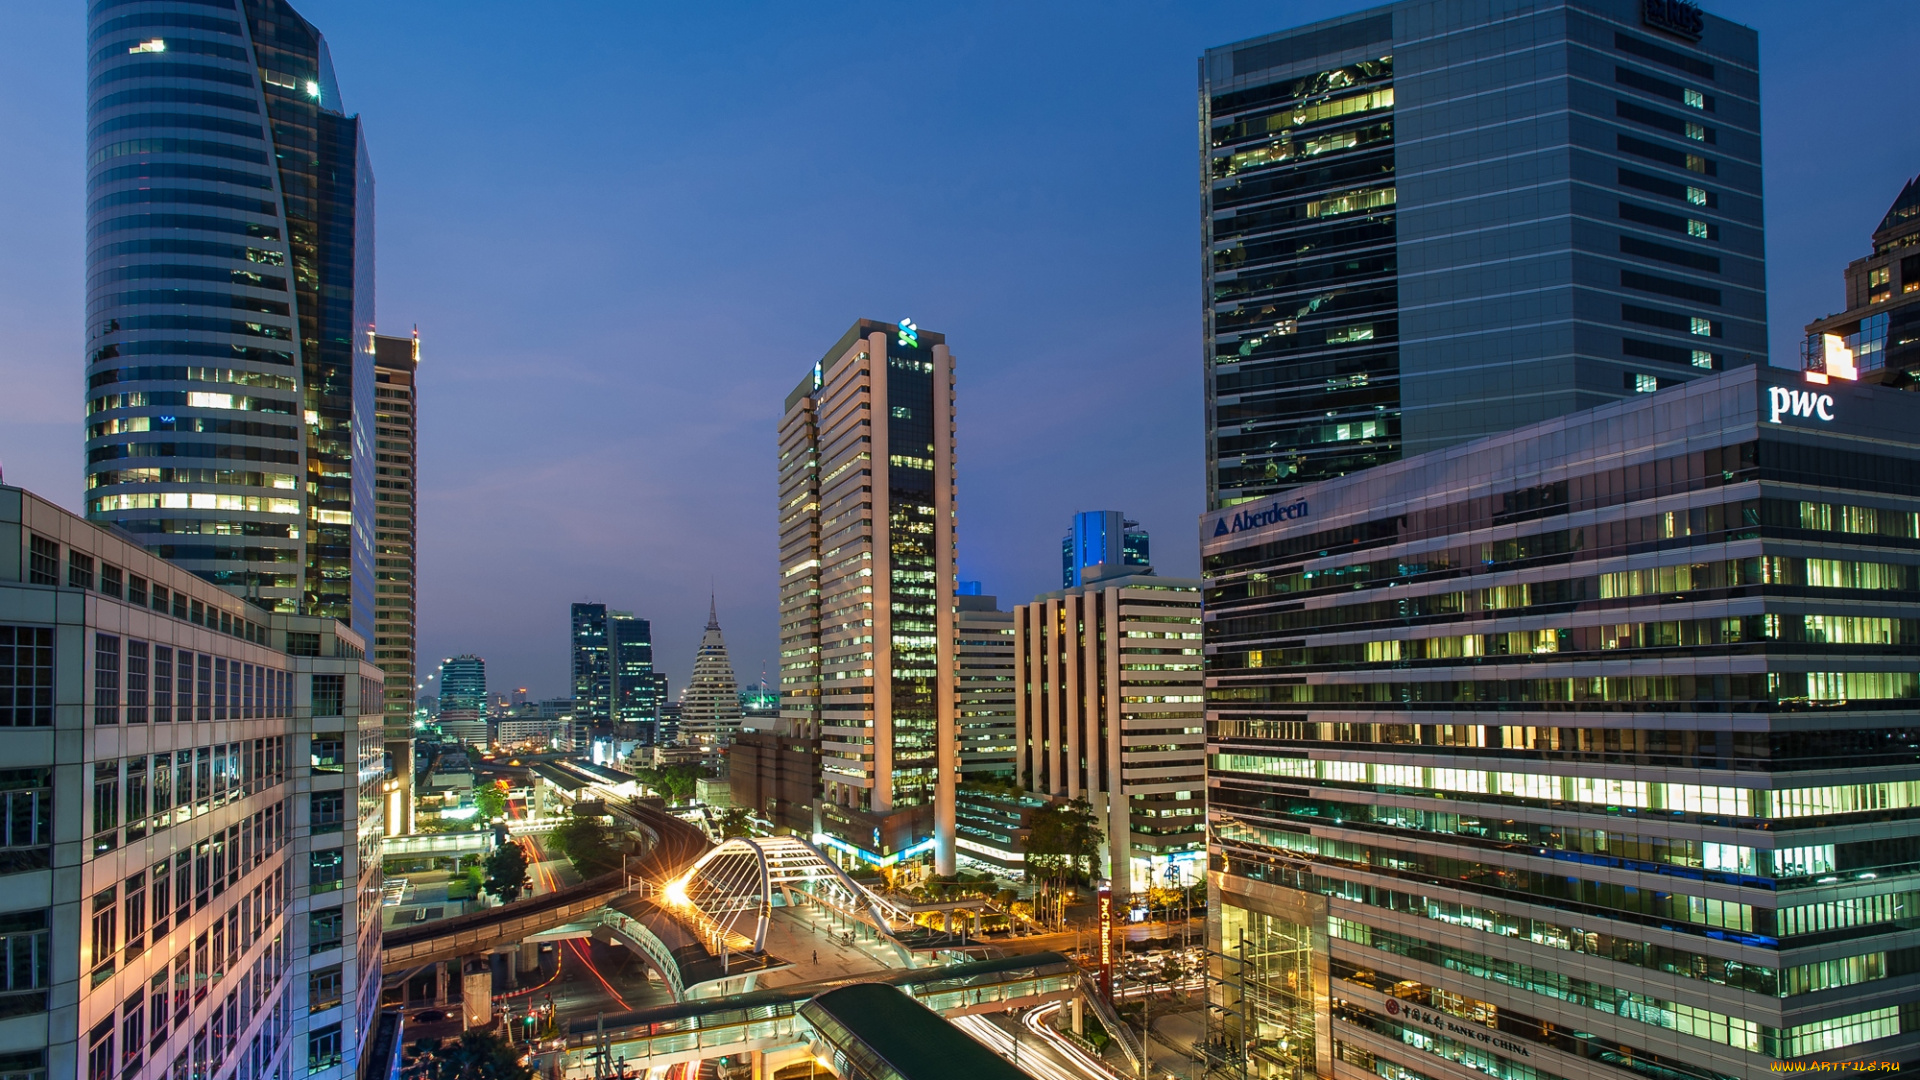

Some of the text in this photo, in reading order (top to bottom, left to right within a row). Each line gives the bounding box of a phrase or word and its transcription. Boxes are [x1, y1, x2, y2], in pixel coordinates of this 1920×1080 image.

[1768, 386, 1834, 424] pwc
[1231, 501, 1308, 533] Aberdeen
[1101, 898, 1110, 920] PwC
[1101, 921, 1111, 965] Thailand
[1447, 1022, 1530, 1057] BANK OF CHINA
